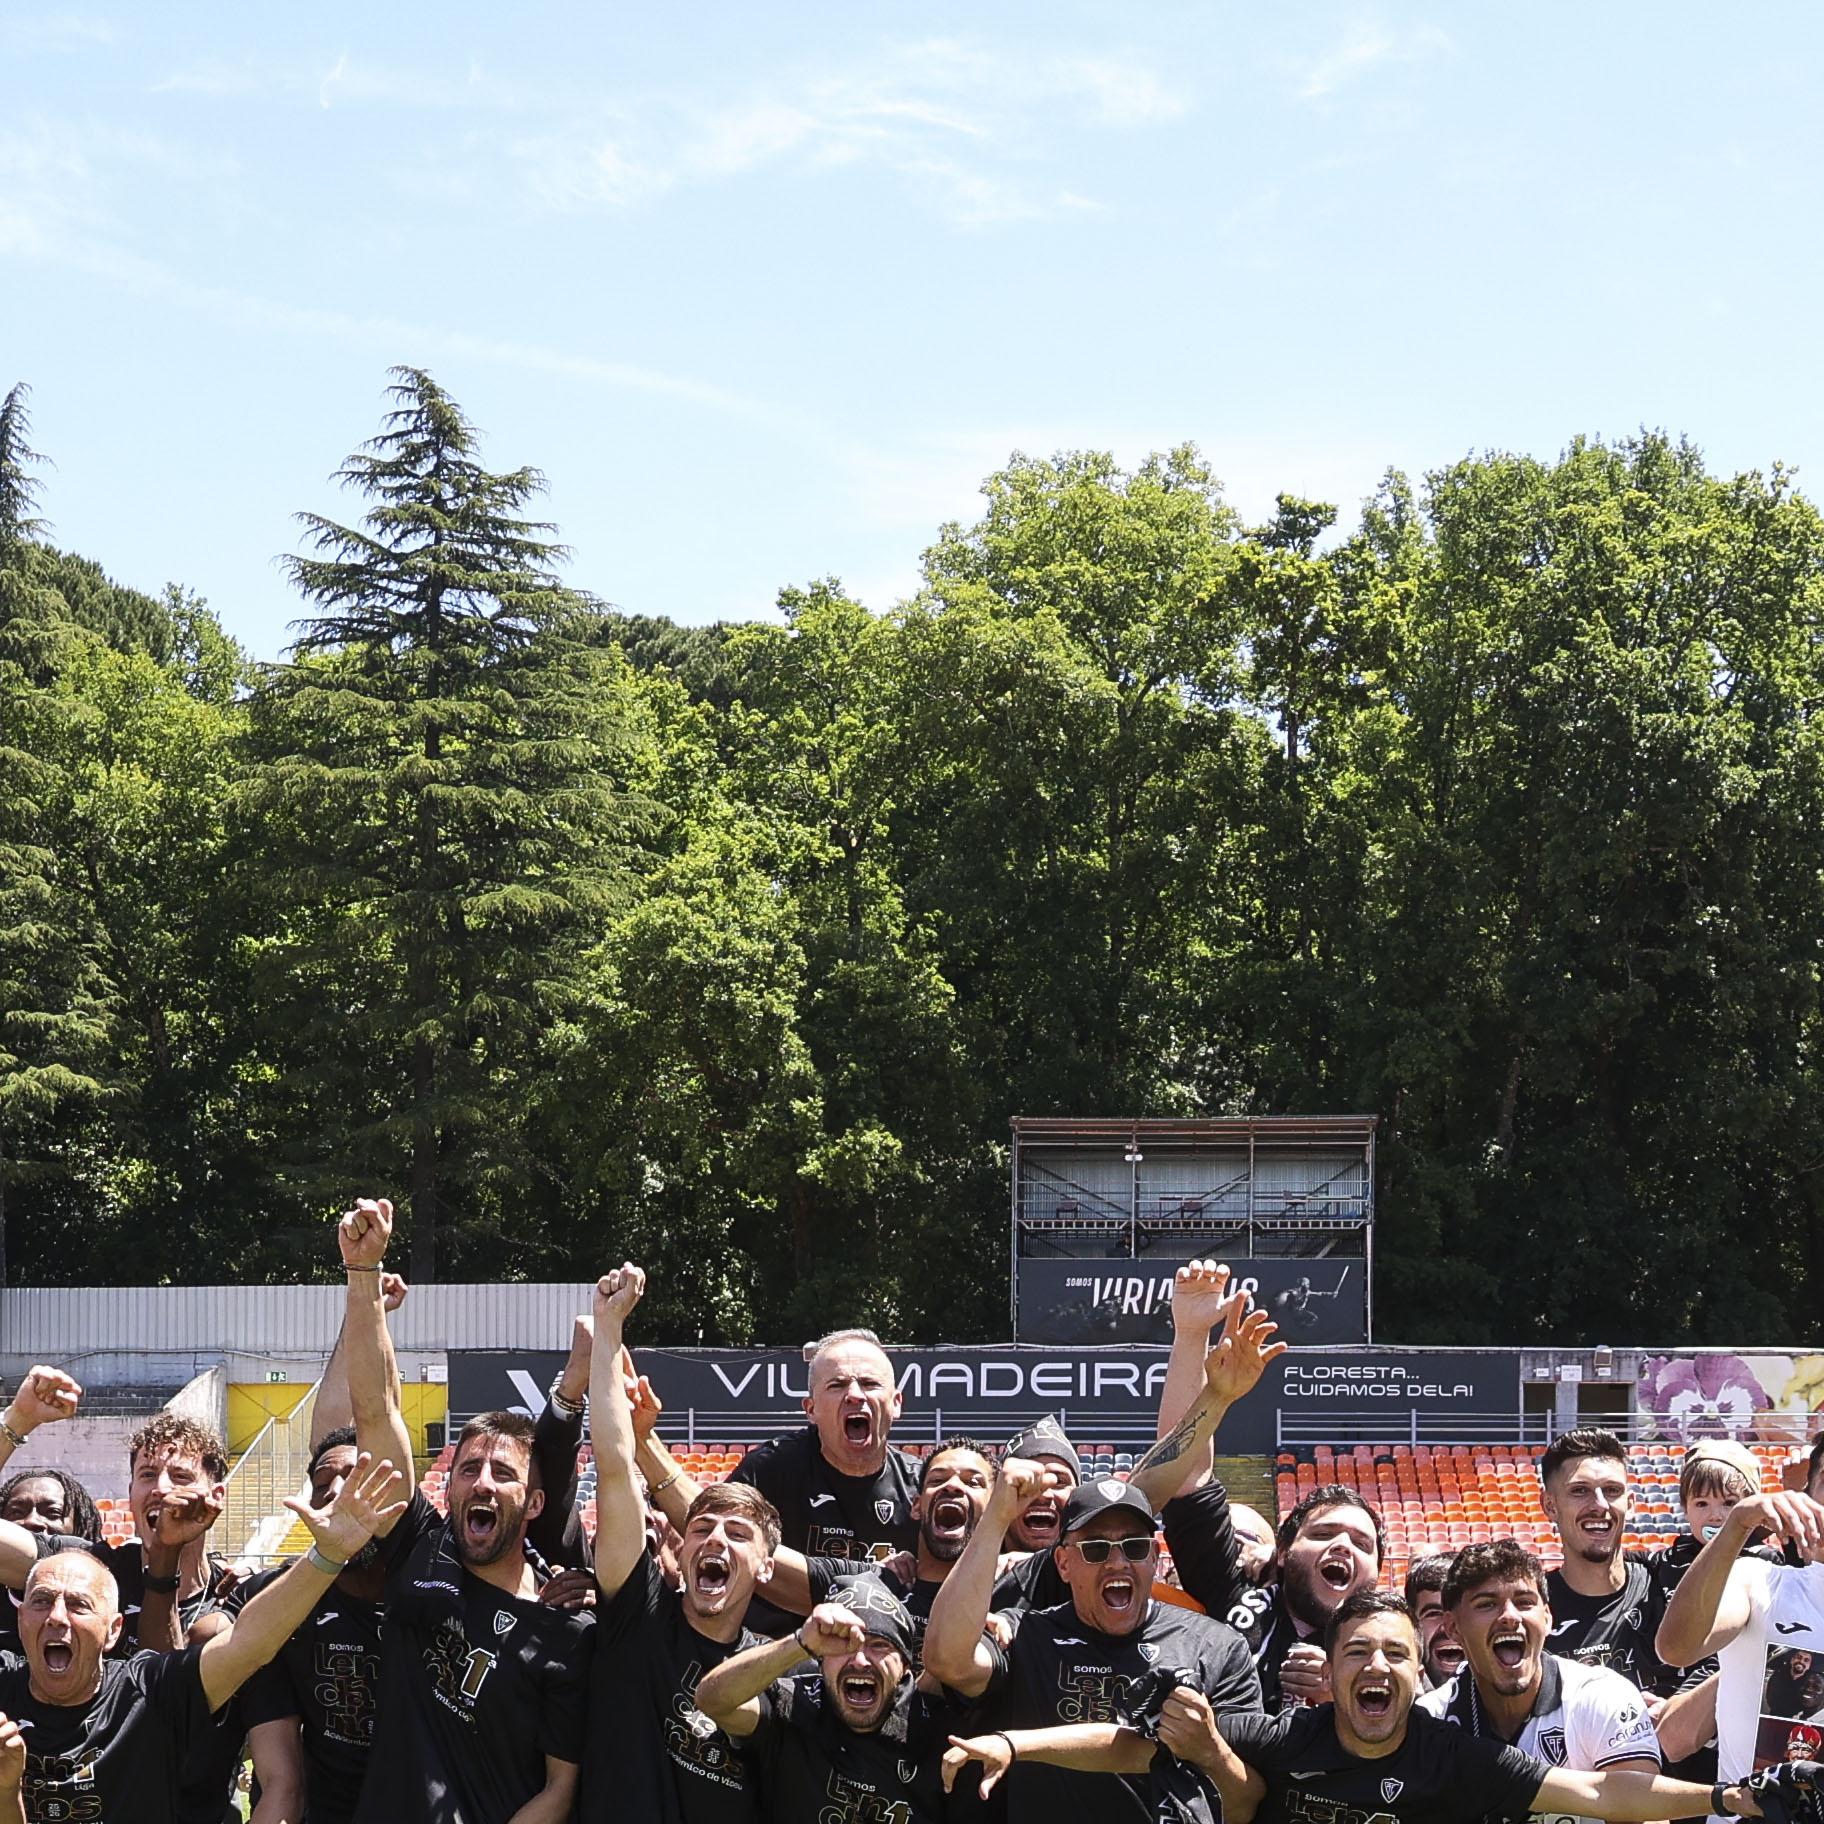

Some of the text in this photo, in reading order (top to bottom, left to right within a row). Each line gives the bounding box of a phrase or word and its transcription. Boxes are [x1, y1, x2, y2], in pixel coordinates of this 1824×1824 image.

[1065, 1278, 1093, 1287] SOMOS
[1284, 1367, 1420, 1379] FLORESTA...
[1283, 1384, 1474, 1397] CUIDAMOS DELA!
[1573, 1643, 1611, 1655] somos
[1073, 1664, 1113, 1673] somos
